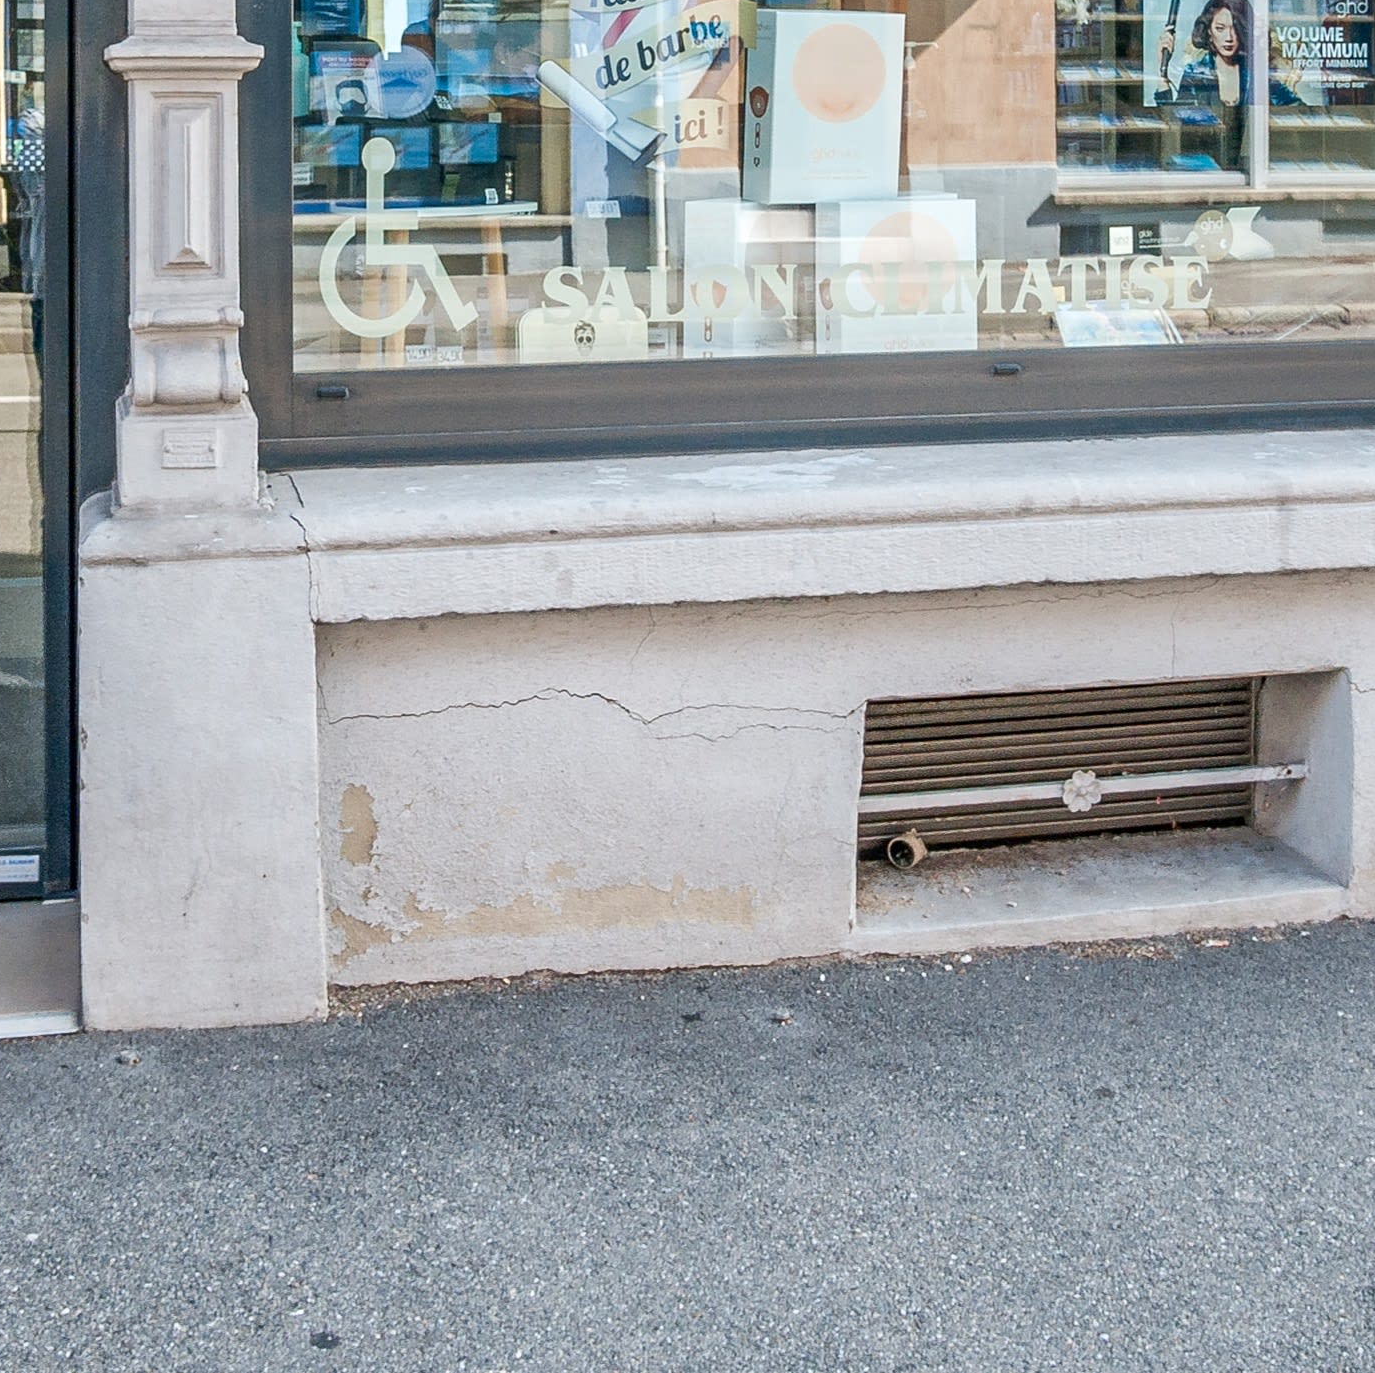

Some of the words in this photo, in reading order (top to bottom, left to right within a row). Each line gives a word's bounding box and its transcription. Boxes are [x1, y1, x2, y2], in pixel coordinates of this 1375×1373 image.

[1276, 27, 1345, 42] VOLUME
[595, 55, 631, 89] de
[636, 14, 724, 72] barbe
[1282, 43, 1369, 58] MAXIMUM
[1293, 59, 1324, 68] EFFORT
[1326, 59, 1368, 68] MINIMUM
[675, 109, 708, 144] ici
[716, 106, 724, 136] !
[1200, 216, 1224, 235] ghd
[542, 262, 798, 325] SALON
[830, 253, 1213, 319] CLIMATISE
